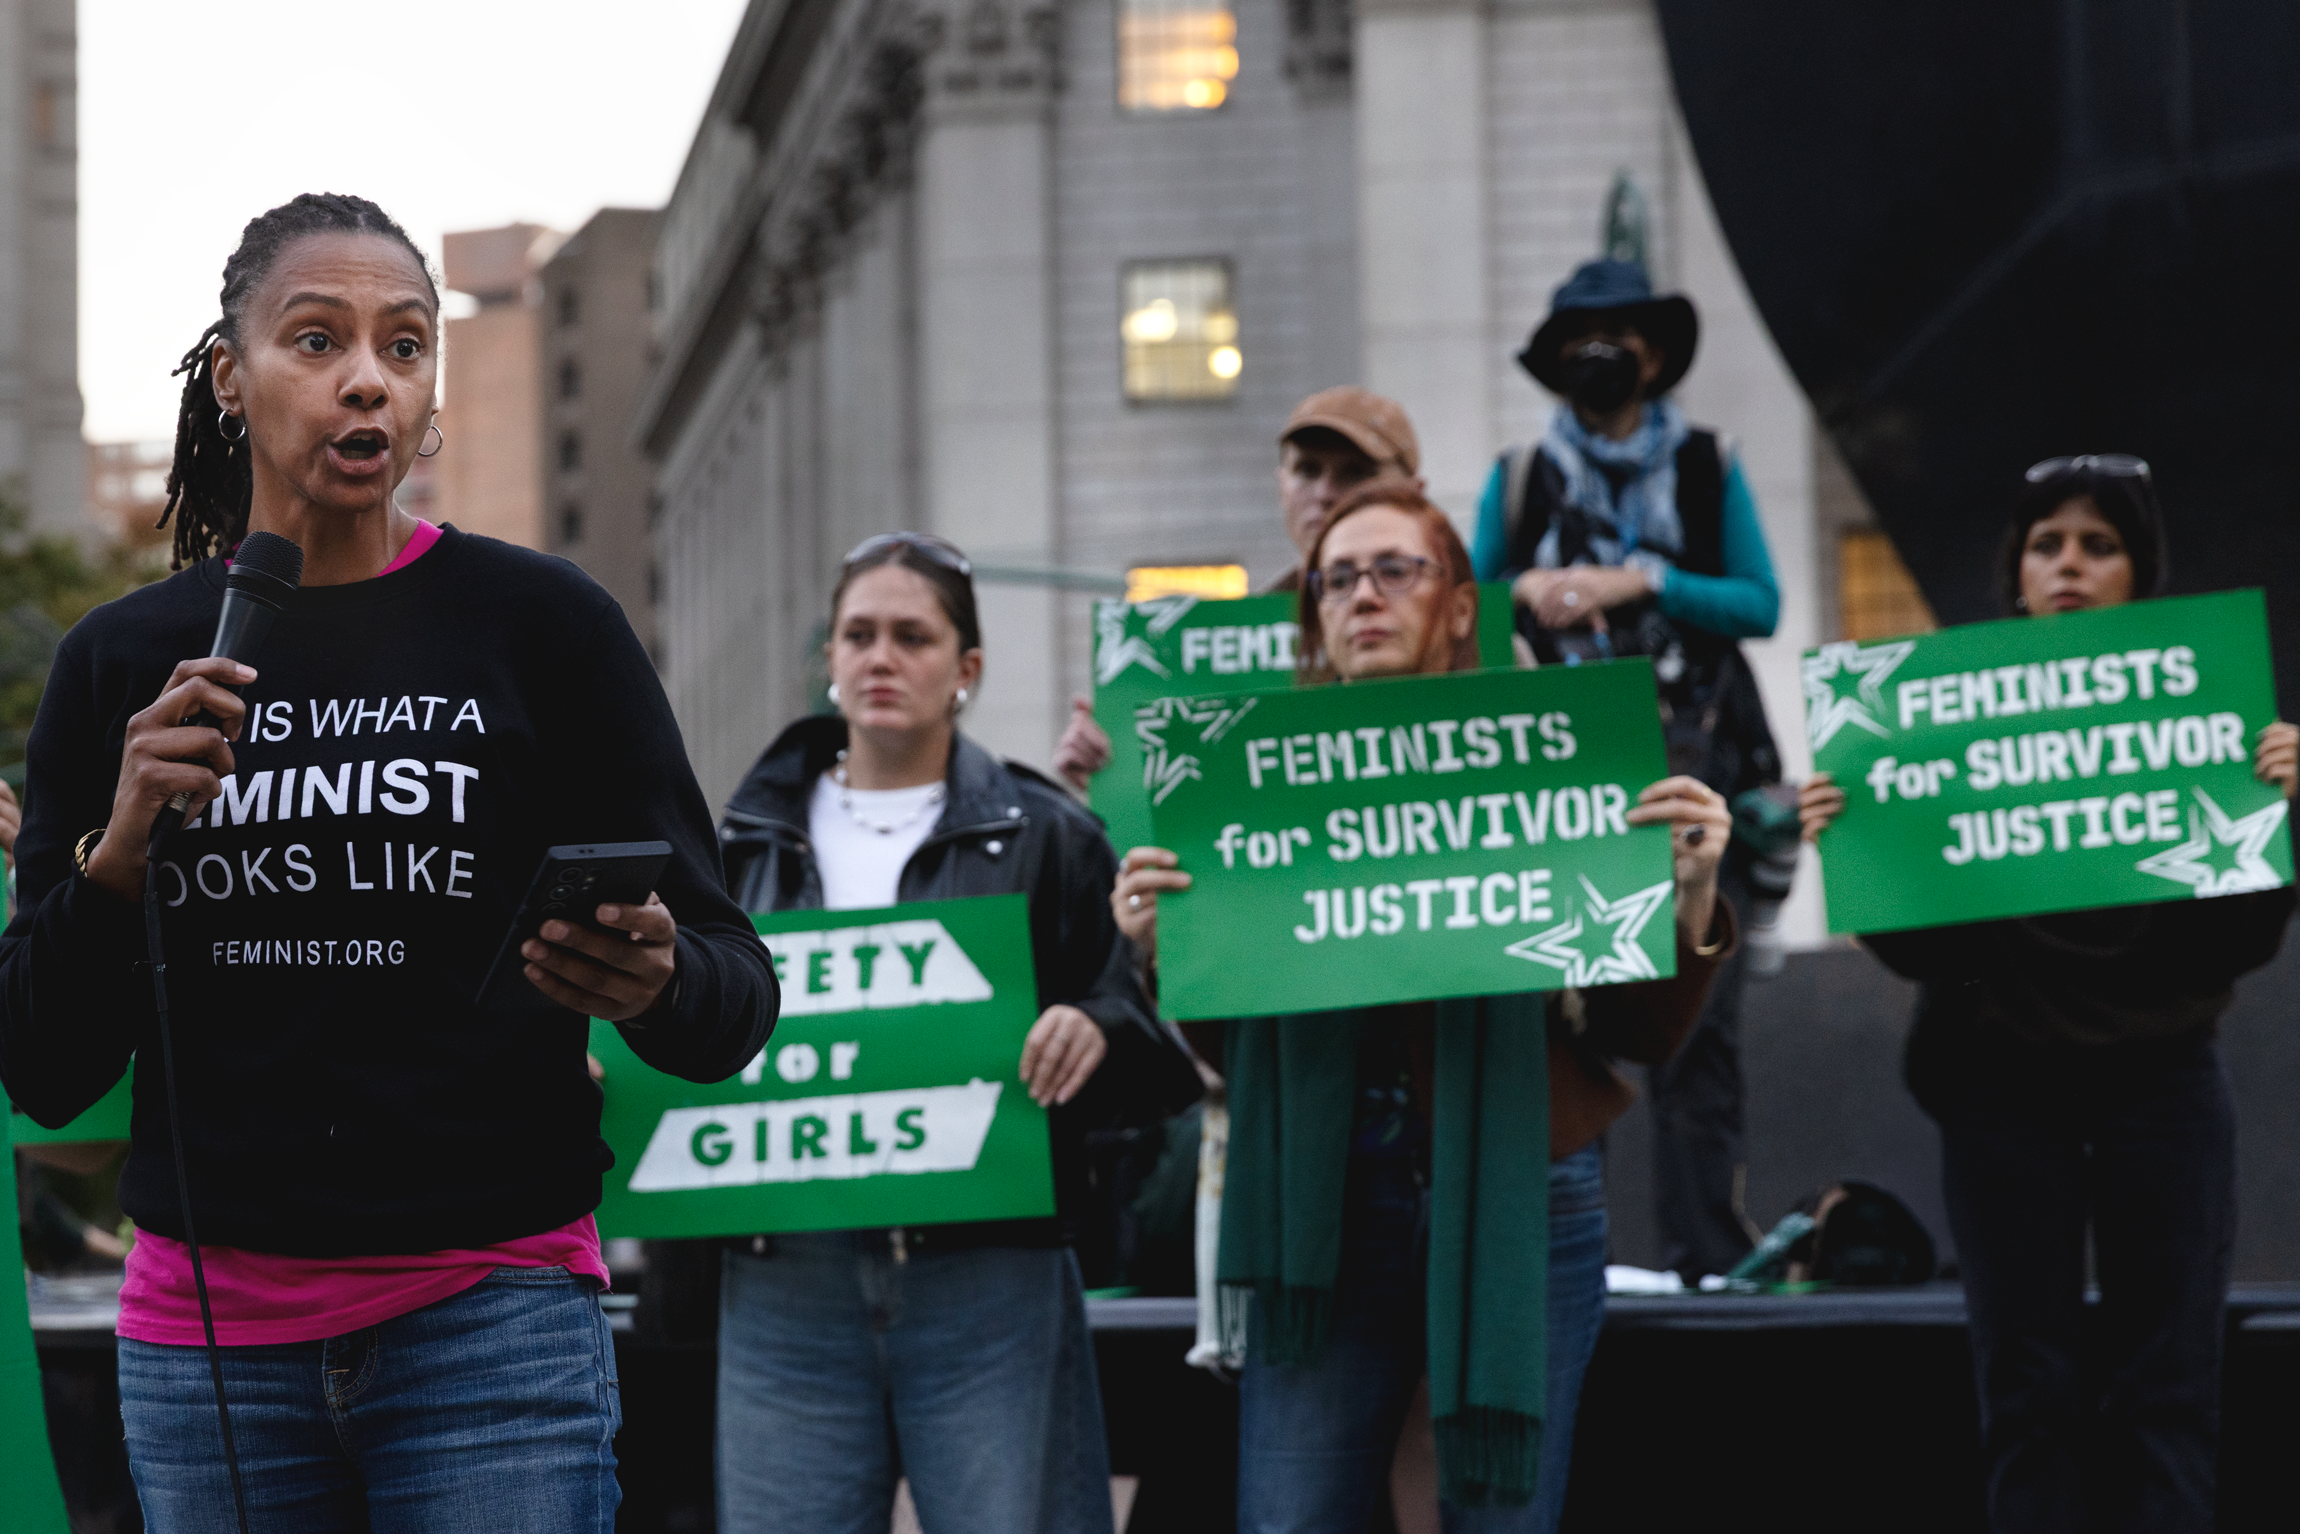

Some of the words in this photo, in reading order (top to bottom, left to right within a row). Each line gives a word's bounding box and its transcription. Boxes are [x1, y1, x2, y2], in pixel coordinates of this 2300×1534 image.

[1181, 621, 1325, 675] FEMI
[250, 700, 294, 743] IS
[309, 695, 448, 739] WHAT
[450, 698, 486, 734] A
[1897, 645, 2199, 730] FEMINISTS
[1246, 712, 1577, 788] FEMINISTS
[1865, 756, 1957, 803] for
[1964, 711, 2247, 791] SURVIVOR
[184, 758, 480, 830] MINIST
[1213, 823, 1312, 869] for
[1325, 783, 1629, 862] SURVIVOR
[1942, 788, 2183, 866] JUSTICE
[346, 841, 475, 899] LIKE
[1292, 867, 1554, 945] JUSTICE
[213, 939, 405, 966] FEMINIST.ORG
[689, 1107, 927, 1169] GIRLS
